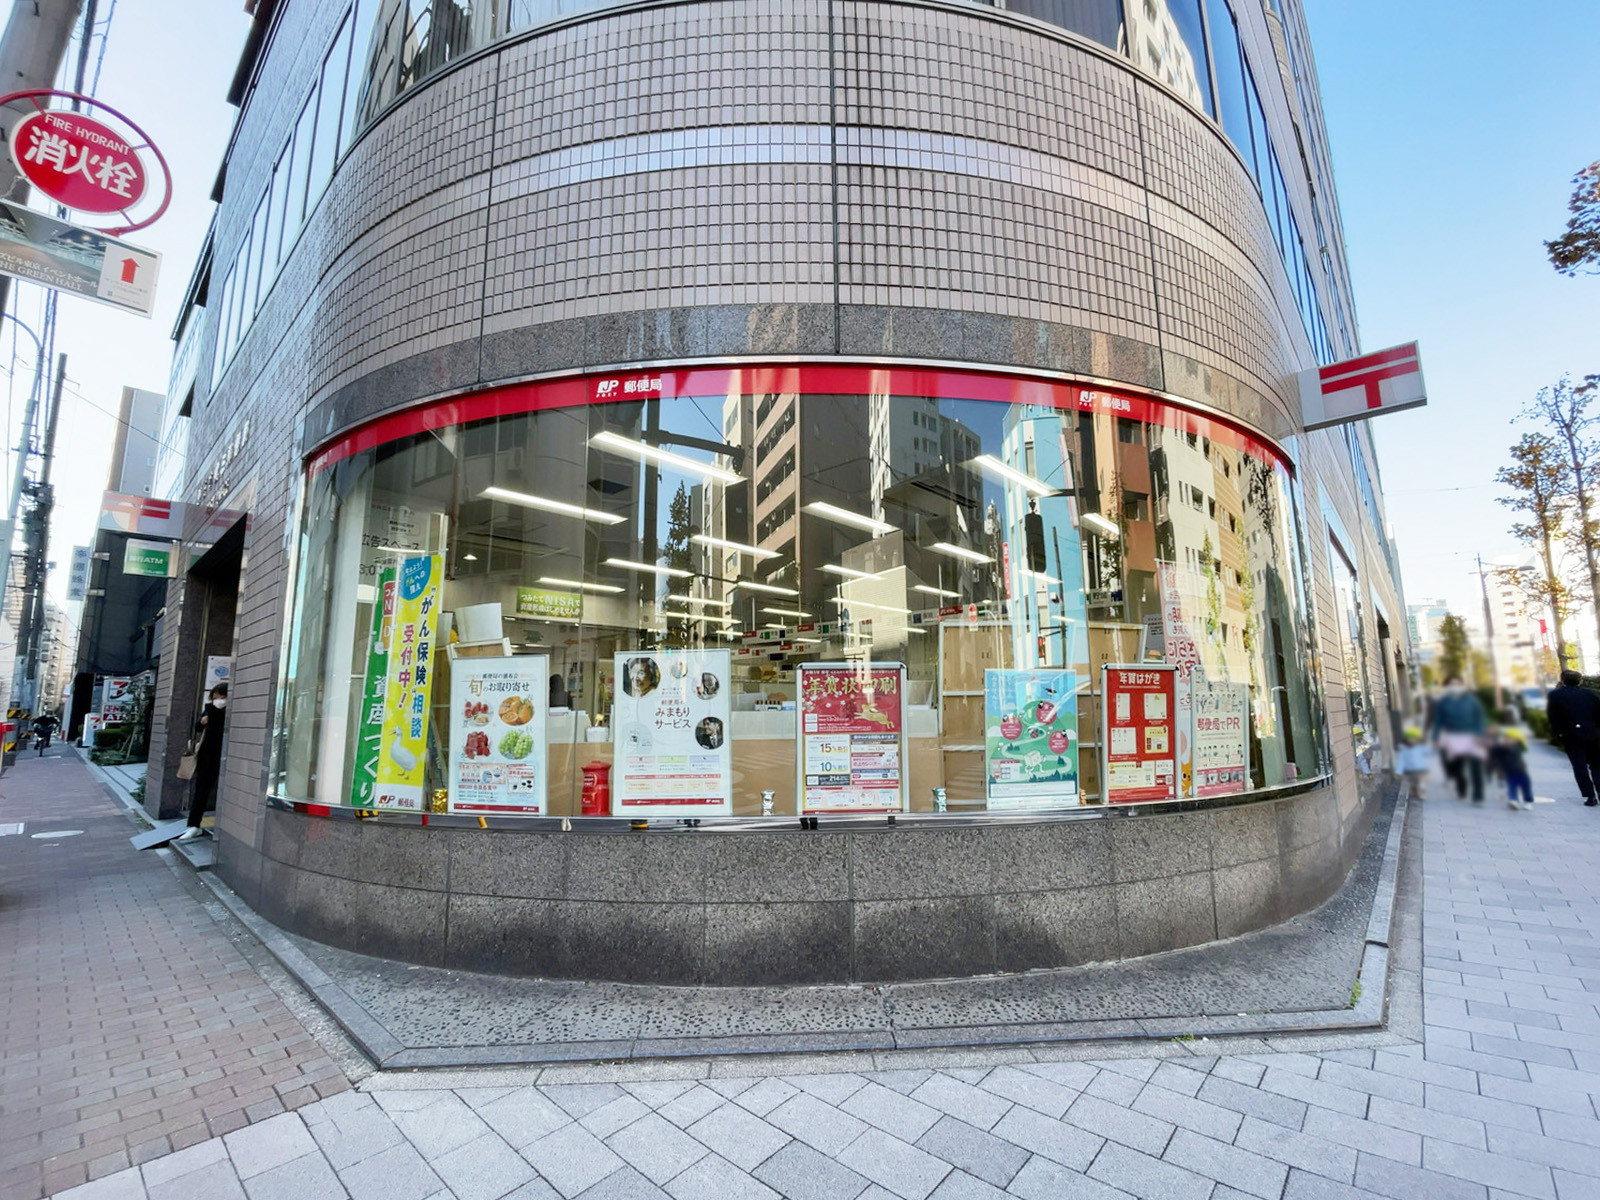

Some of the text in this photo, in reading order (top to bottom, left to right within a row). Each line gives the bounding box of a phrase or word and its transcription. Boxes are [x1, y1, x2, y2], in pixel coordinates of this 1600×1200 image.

[44, 114, 130, 156] FIRE HYDRANT
[24, 126, 137, 199] 消火栓
[17, 265, 54, 282] GREEN
[55, 279, 83, 292] HALL
[624, 379, 662, 393] 郵便局
[1101, 396, 1131, 412] 郵便局
[808, 675, 897, 696] 年賀状印刷
[1119, 672, 1160, 685] 年賀はがき
[655, 707, 690, 718] みまもり
[654, 719, 692, 729] サービス
[1197, 717, 1240, 731] 郵便局でPR
